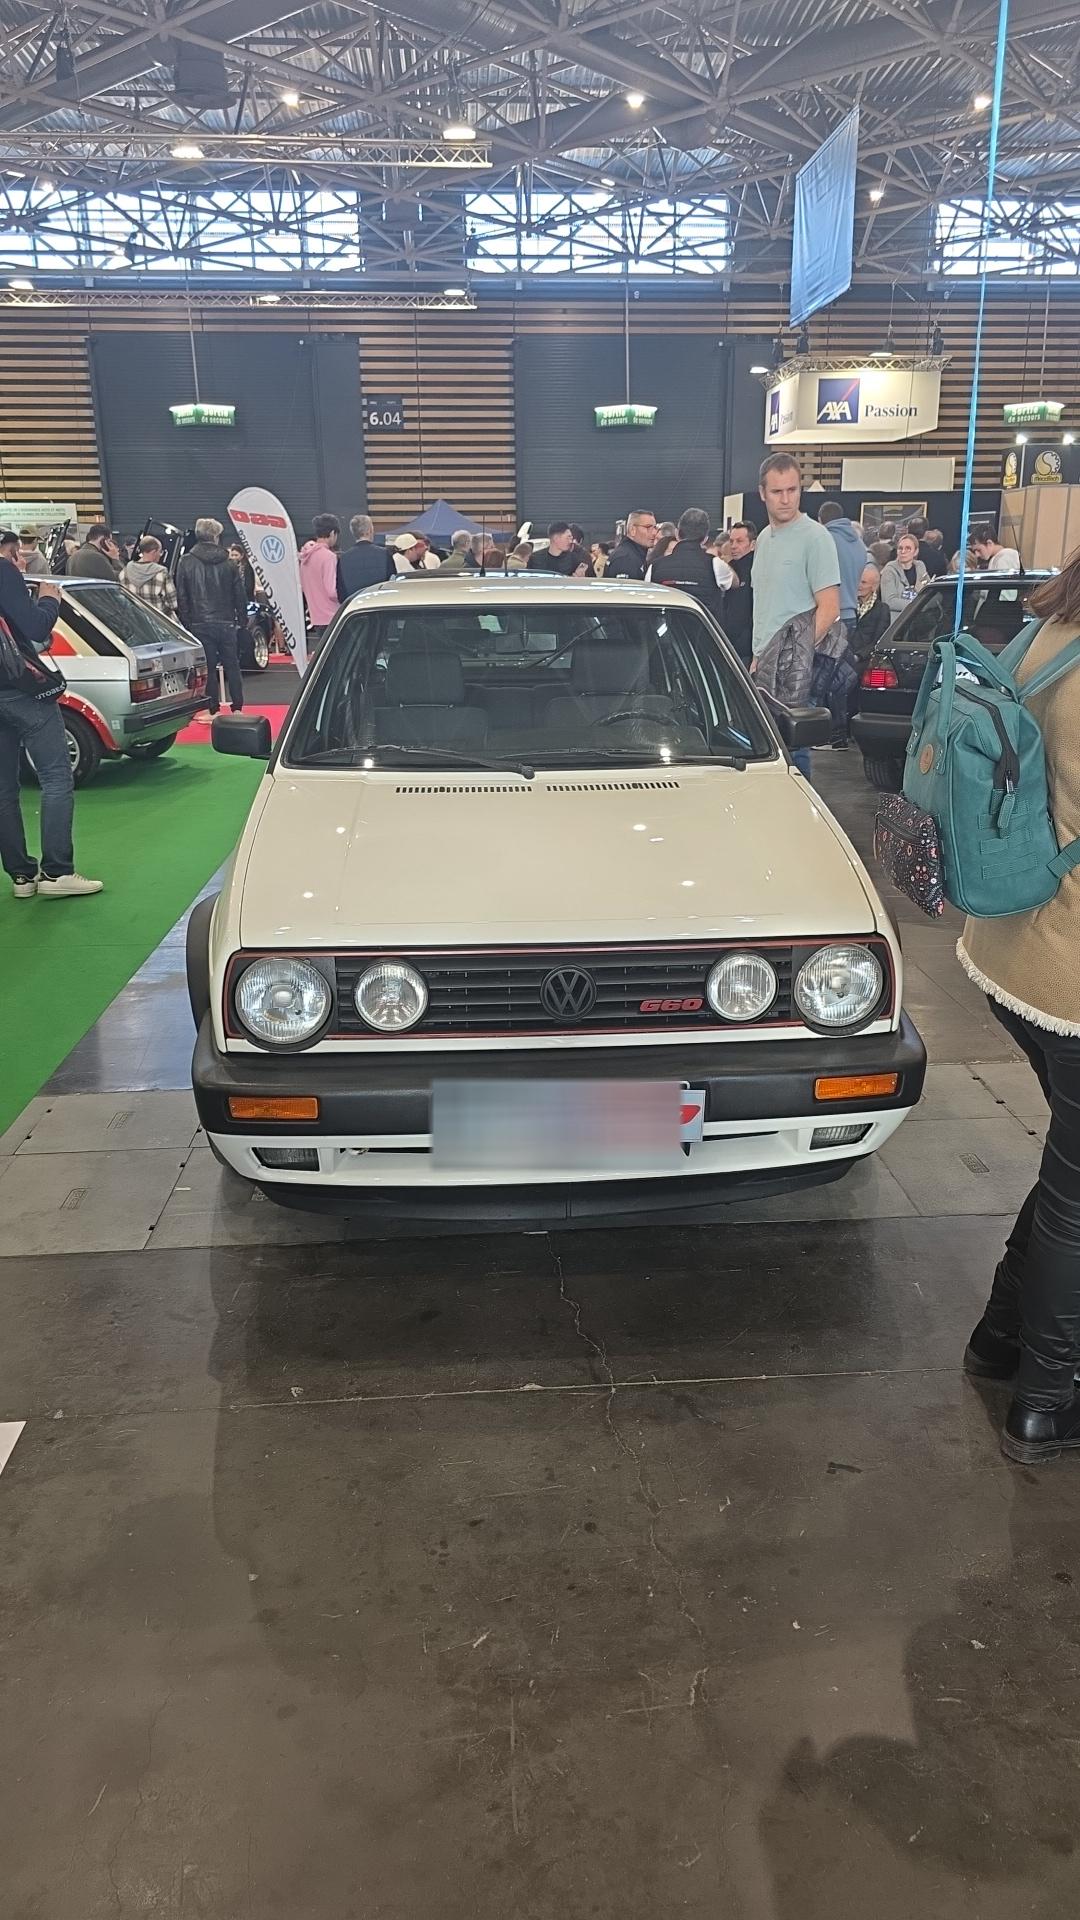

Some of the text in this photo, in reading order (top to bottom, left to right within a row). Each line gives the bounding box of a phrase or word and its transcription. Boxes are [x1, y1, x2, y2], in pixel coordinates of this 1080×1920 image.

[369, 411, 402, 426] 6.04
[817, 401, 918, 421] AXA Passion
[1011, 406, 1039, 416] Sortie
[1017, 414, 1041, 422] secours
[639, 998, 704, 1013] G60
